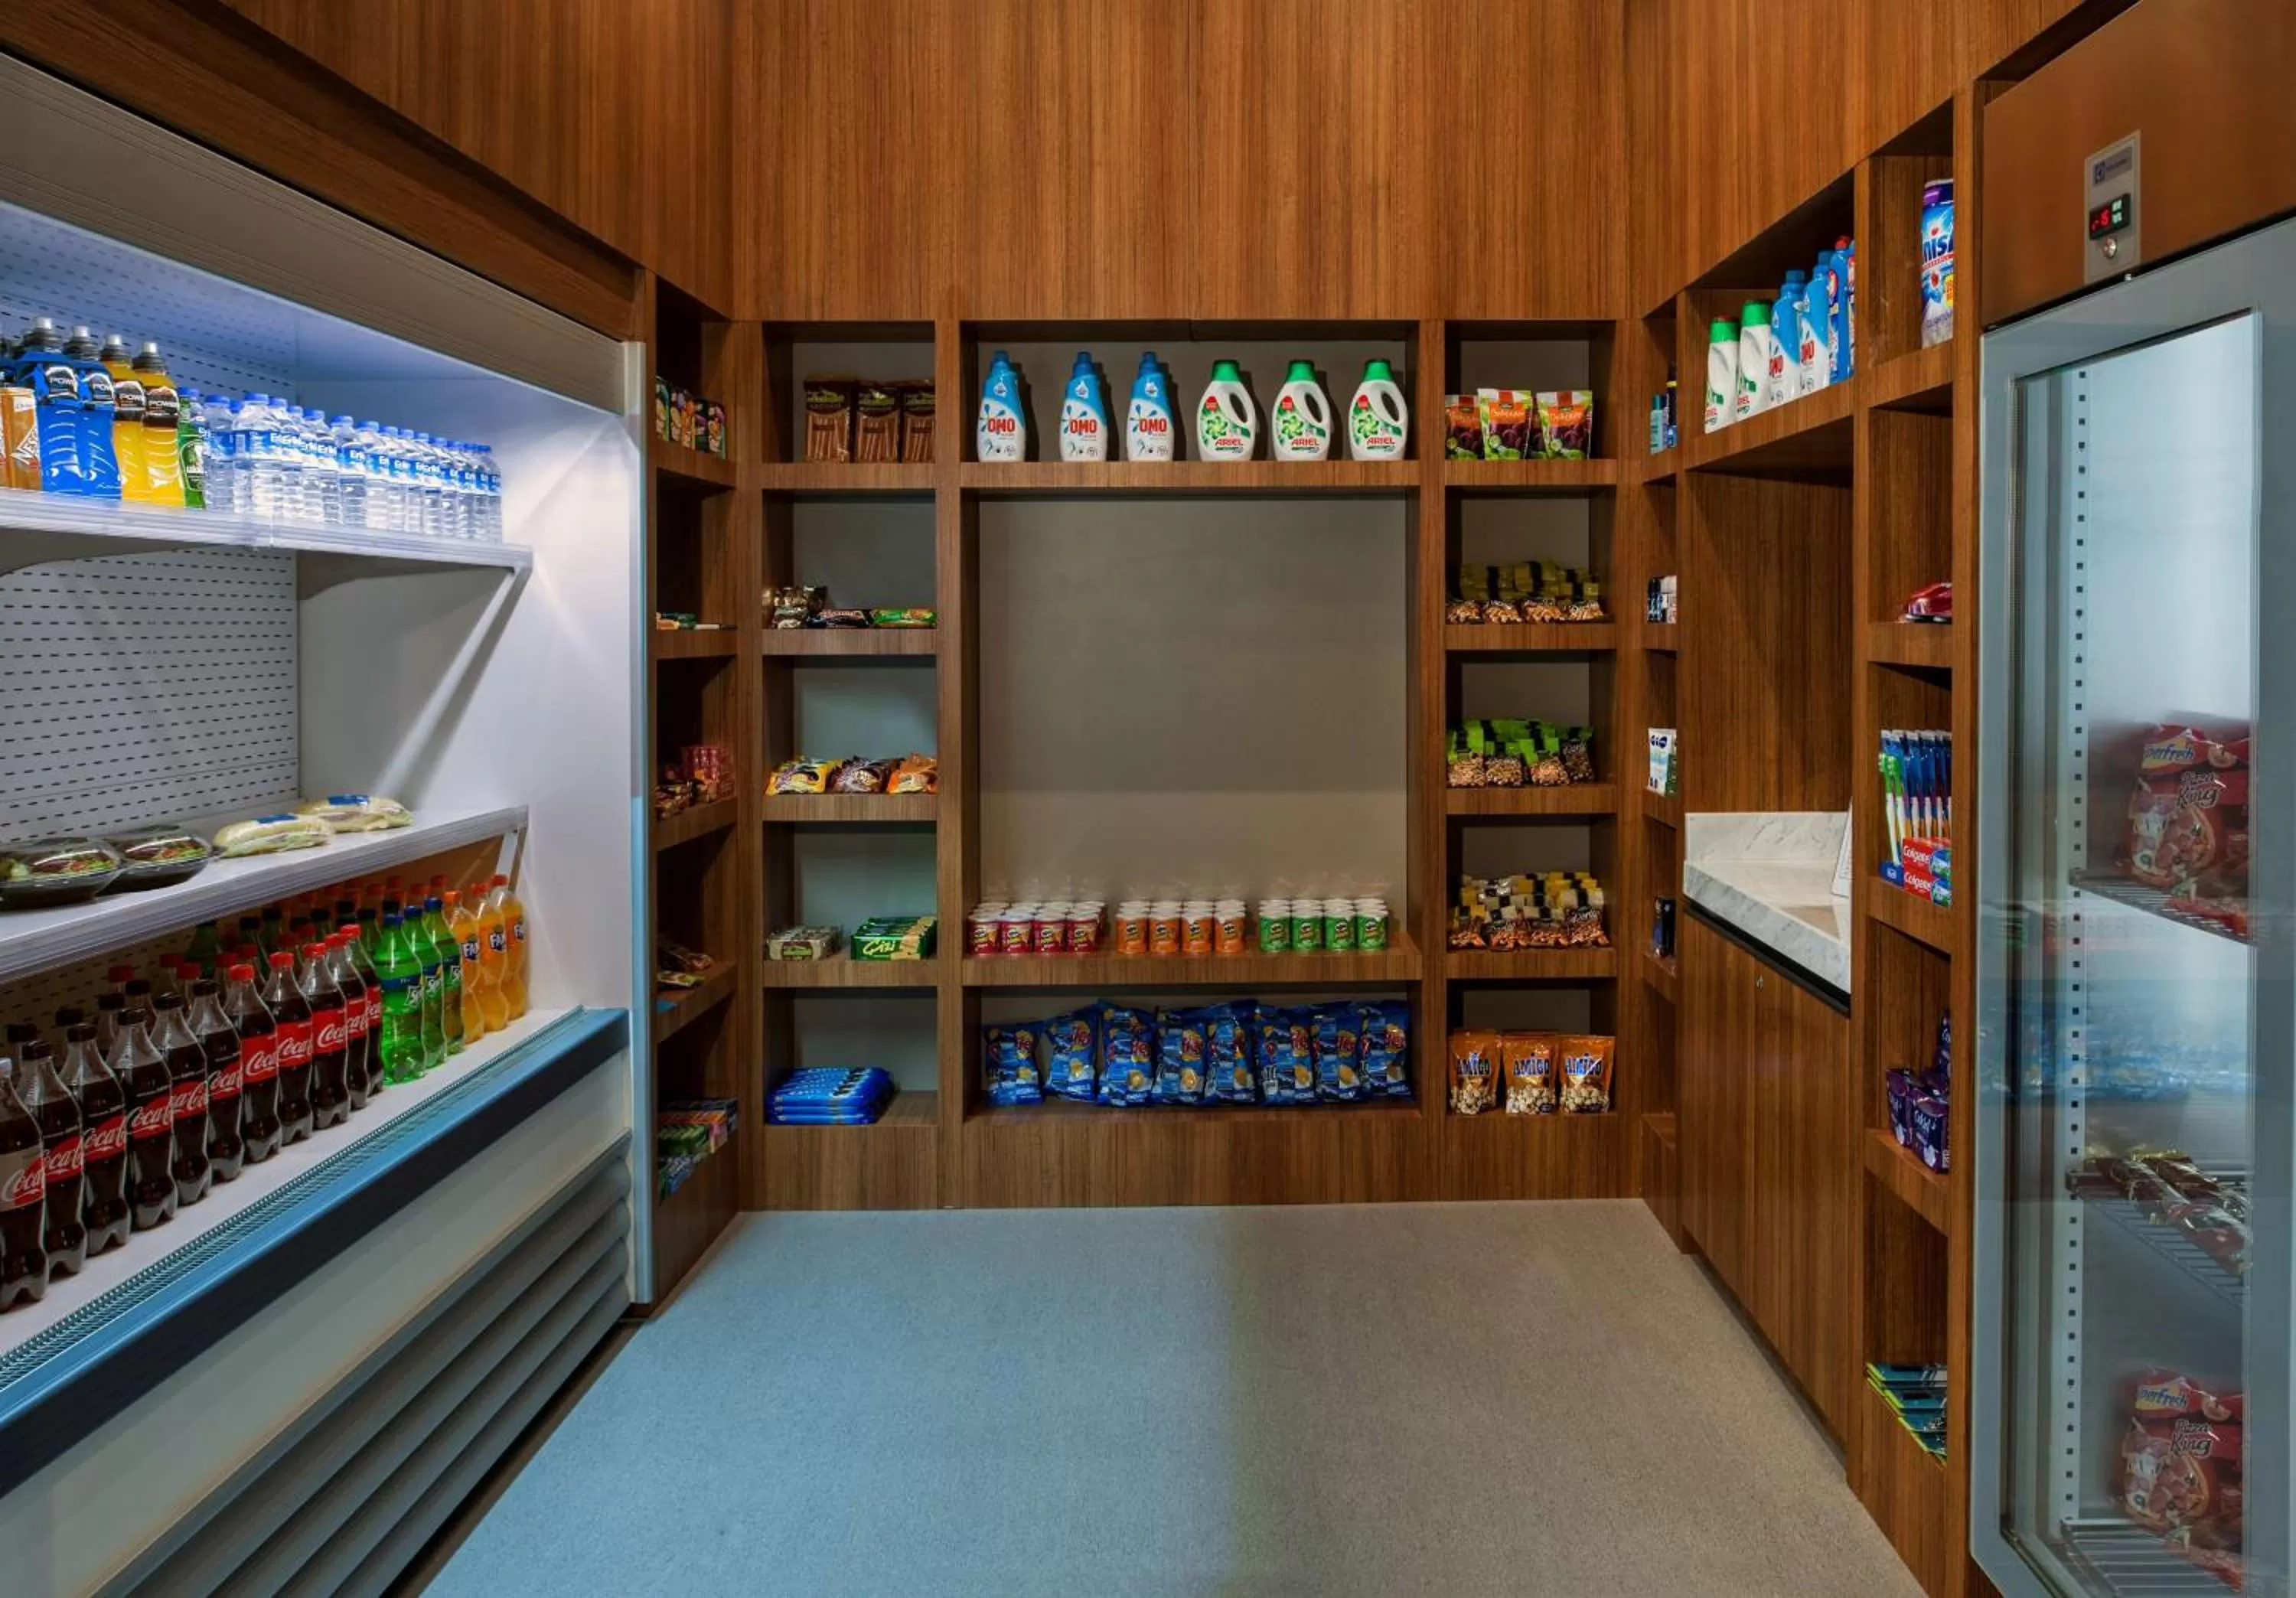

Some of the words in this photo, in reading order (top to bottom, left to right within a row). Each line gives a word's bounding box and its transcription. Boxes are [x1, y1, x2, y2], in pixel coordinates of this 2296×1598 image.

[988, 419, 1016, 433] OMO
[1071, 419, 1097, 434] OMO
[1139, 419, 1166, 433] OMO
[1215, 438, 1244, 446] ARIEL
[1291, 438, 1319, 446] ARIEL
[1367, 436, 1395, 445] ARIEL
[1903, 846, 1931, 864] Colgate
[1903, 872, 1932, 892] Colgate
